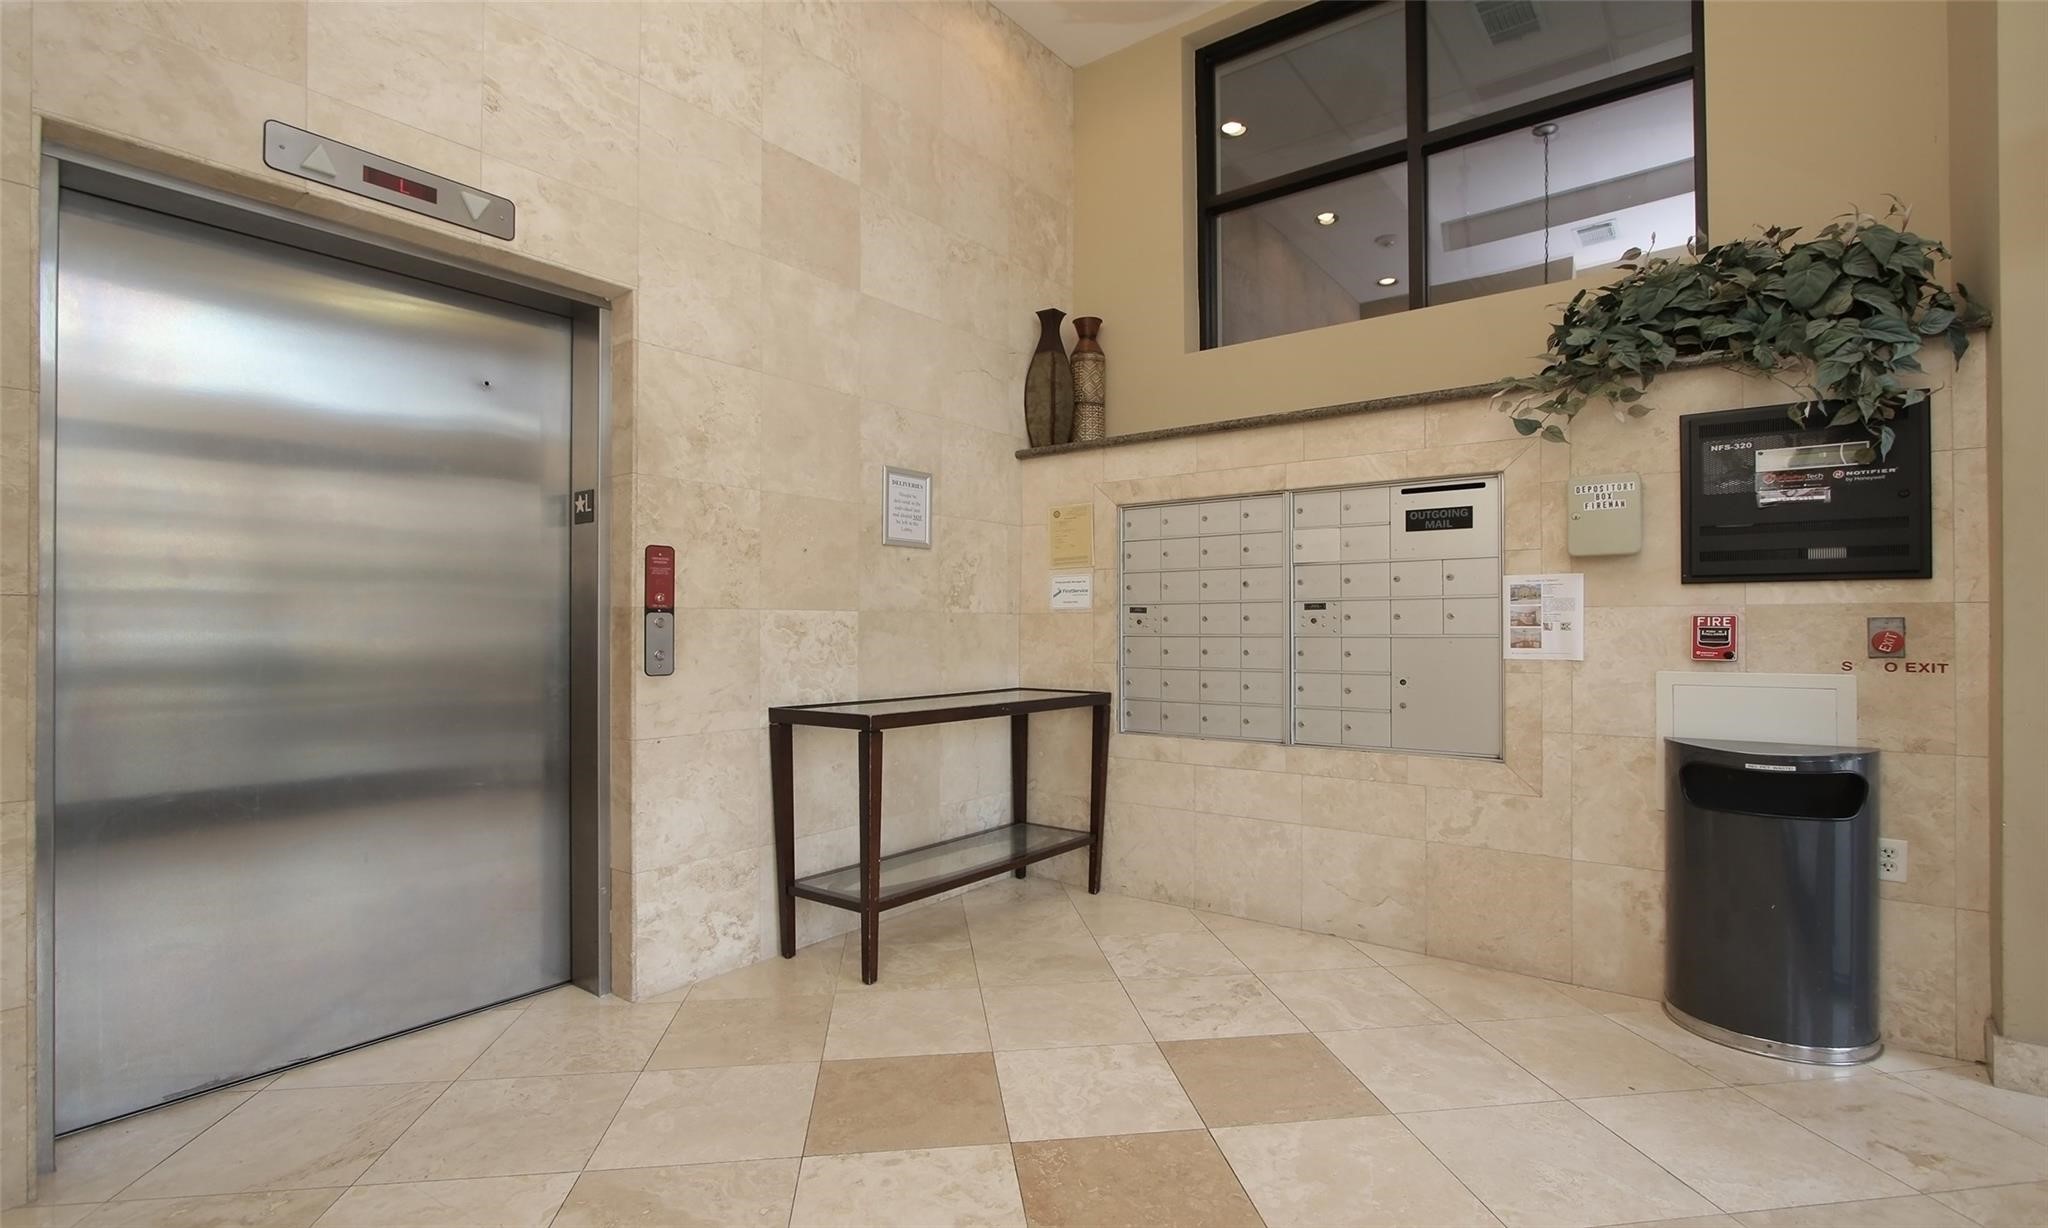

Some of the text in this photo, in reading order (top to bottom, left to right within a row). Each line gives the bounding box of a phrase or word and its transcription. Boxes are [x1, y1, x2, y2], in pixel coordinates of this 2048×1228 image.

[1711, 442, 1752, 451] NFS-320
[1846, 467, 1897, 476] NOTIFIER
[1575, 482, 1634, 494] DEPOSITORY
[585, 493, 592, 512] L
[1595, 493, 1612, 501] BOX
[1584, 500, 1625, 510] FIREMAN
[1409, 508, 1469, 520] OUTGOING
[1425, 520, 1453, 529] MAIL
[1697, 616, 1732, 627] FIRE
[1878, 632, 1898, 652] EXIT
[1905, 662, 1949, 674] EXIT
